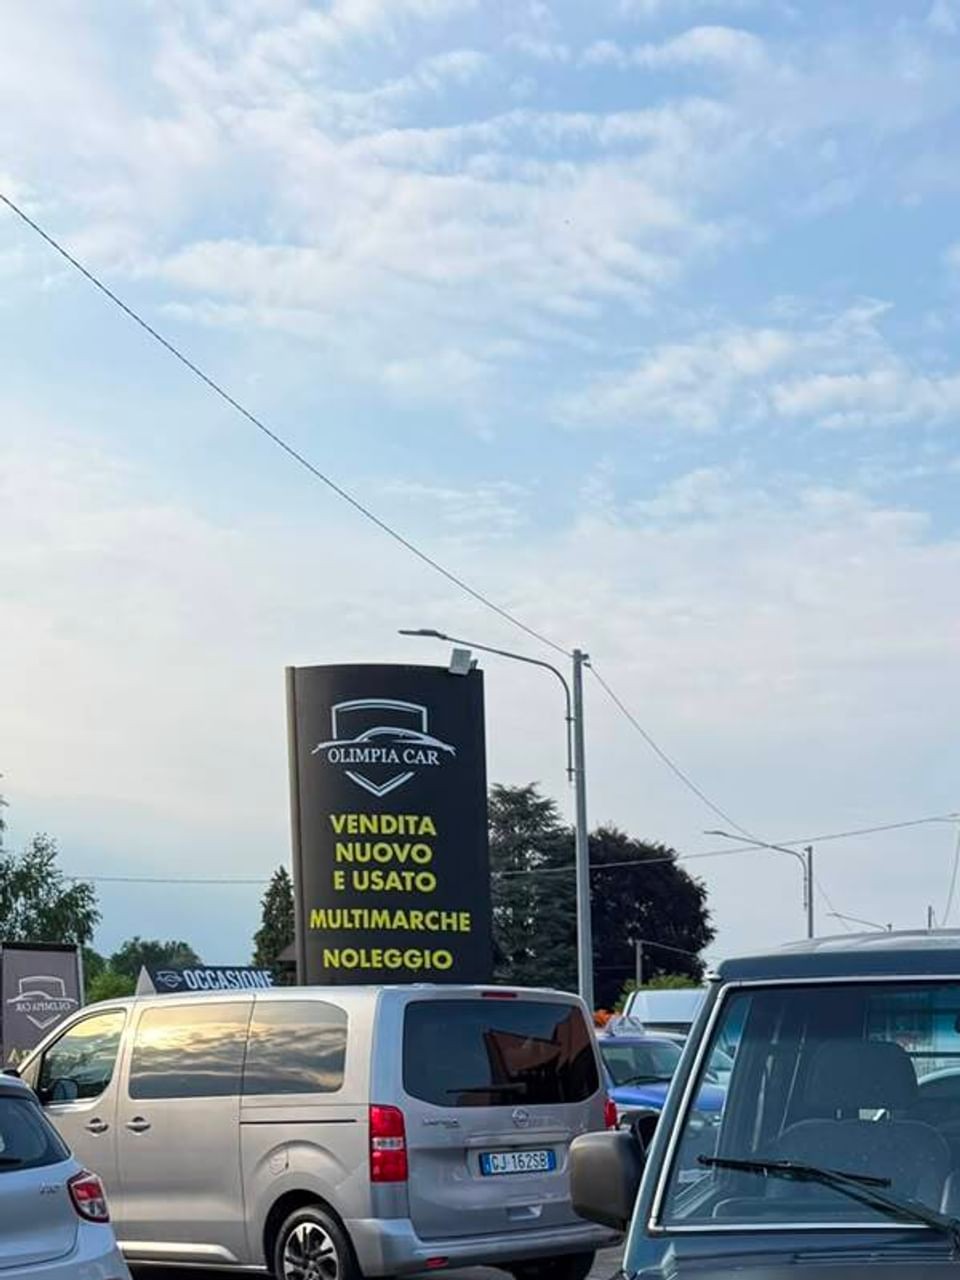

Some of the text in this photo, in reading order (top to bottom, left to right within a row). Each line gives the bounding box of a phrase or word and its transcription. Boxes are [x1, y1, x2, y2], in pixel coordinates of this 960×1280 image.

[327, 748, 440, 765] OLIMPIA CAR
[330, 814, 437, 835] VENDITA
[335, 842, 433, 864] NUOVO
[333, 870, 437, 892] E USATO
[310, 909, 471, 931] MULTIMARCHE
[323, 949, 453, 969] NOLEGGIO
[182, 969, 274, 989] OCCASIONE
